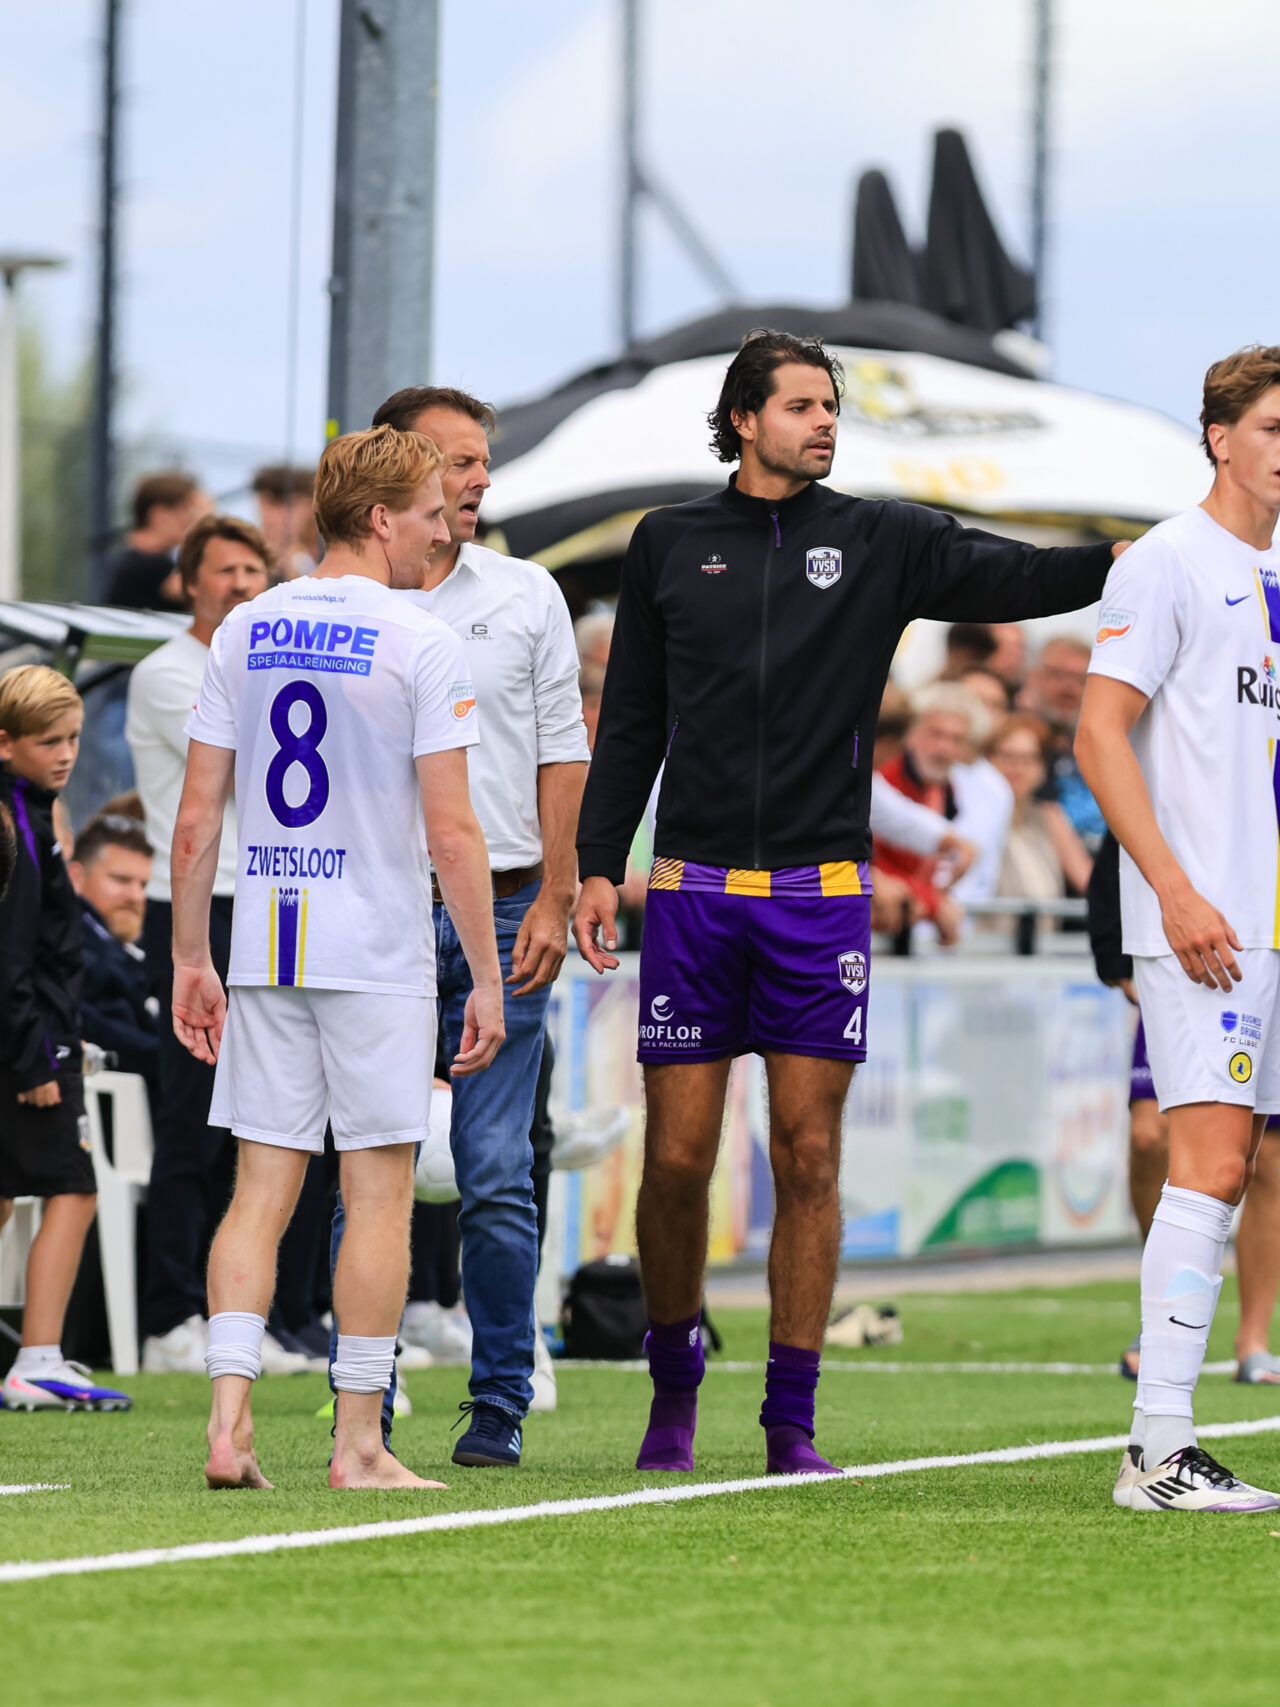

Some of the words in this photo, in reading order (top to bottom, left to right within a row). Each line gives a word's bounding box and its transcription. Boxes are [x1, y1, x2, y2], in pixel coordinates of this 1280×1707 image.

[812, 560, 836, 572] VVSB
[249, 617, 379, 657] POMPE
[471, 624, 488, 635] G
[265, 679, 330, 828] 8
[247, 846, 346, 879] ZWETSLOOT
[845, 964, 864, 977] VVSB
[843, 1006, 862, 1046] 4
[1224, 1036, 1236, 1044] FC
